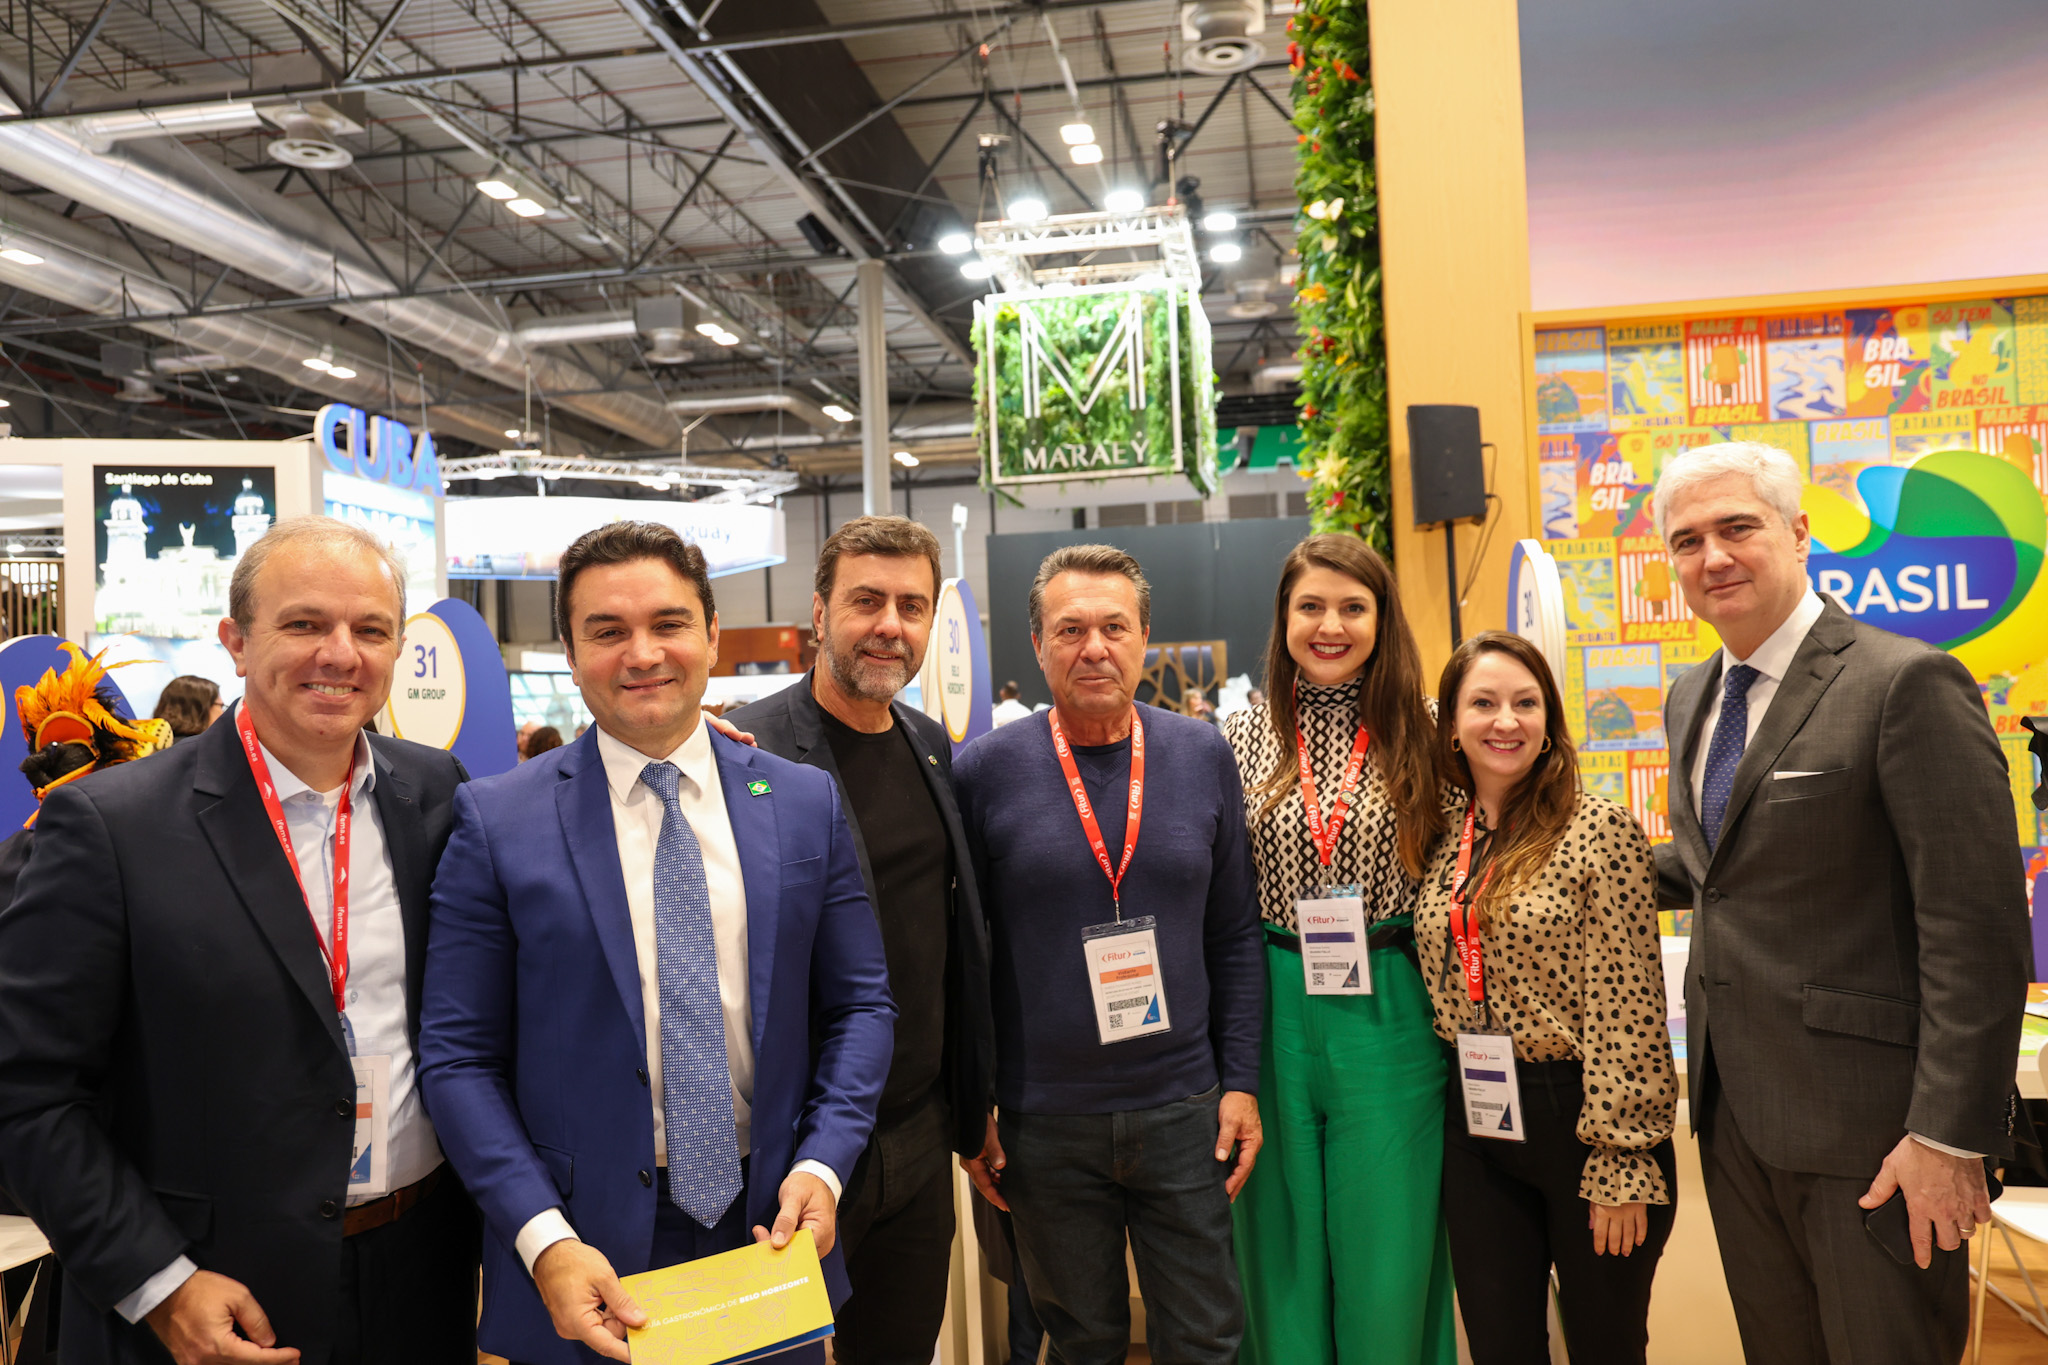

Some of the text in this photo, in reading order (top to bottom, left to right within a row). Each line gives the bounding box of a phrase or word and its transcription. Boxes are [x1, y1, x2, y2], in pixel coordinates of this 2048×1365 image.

[1958, 306, 1992, 323] TEM
[1536, 330, 1602, 354] BRASIL
[1863, 336, 1910, 362] BRA
[1864, 363, 1907, 389] SIL
[1936, 386, 2011, 409] BRASIL
[1693, 404, 1763, 425] BRASIL
[1979, 407, 2030, 425] MADE
[1677, 432, 1711, 447] TEM
[1815, 417, 1887, 444] BRASIL
[314, 402, 445, 498] CUBA
[1023, 439, 1150, 471] MARAEY
[105, 472, 213, 487] Santiago de Cuba
[1589, 461, 1635, 487] BRA
[1590, 487, 1631, 511] SIL
[1807, 563, 1989, 616] RASIL
[948, 617, 960, 655] 30
[1624, 621, 1694, 641] BRASIL
[414, 644, 437, 678] 31
[1588, 647, 1657, 668] BRASIL
[407, 688, 446, 700] GM GROUP
[244, 730, 259, 762] ifema.es
[275, 819, 292, 854] ifema.es
[337, 906, 345, 941] ifema.es
[727, 1298, 738, 1308] DE
[739, 1292, 760, 1304] BELO
[761, 1276, 809, 1297] HORIZONTE
